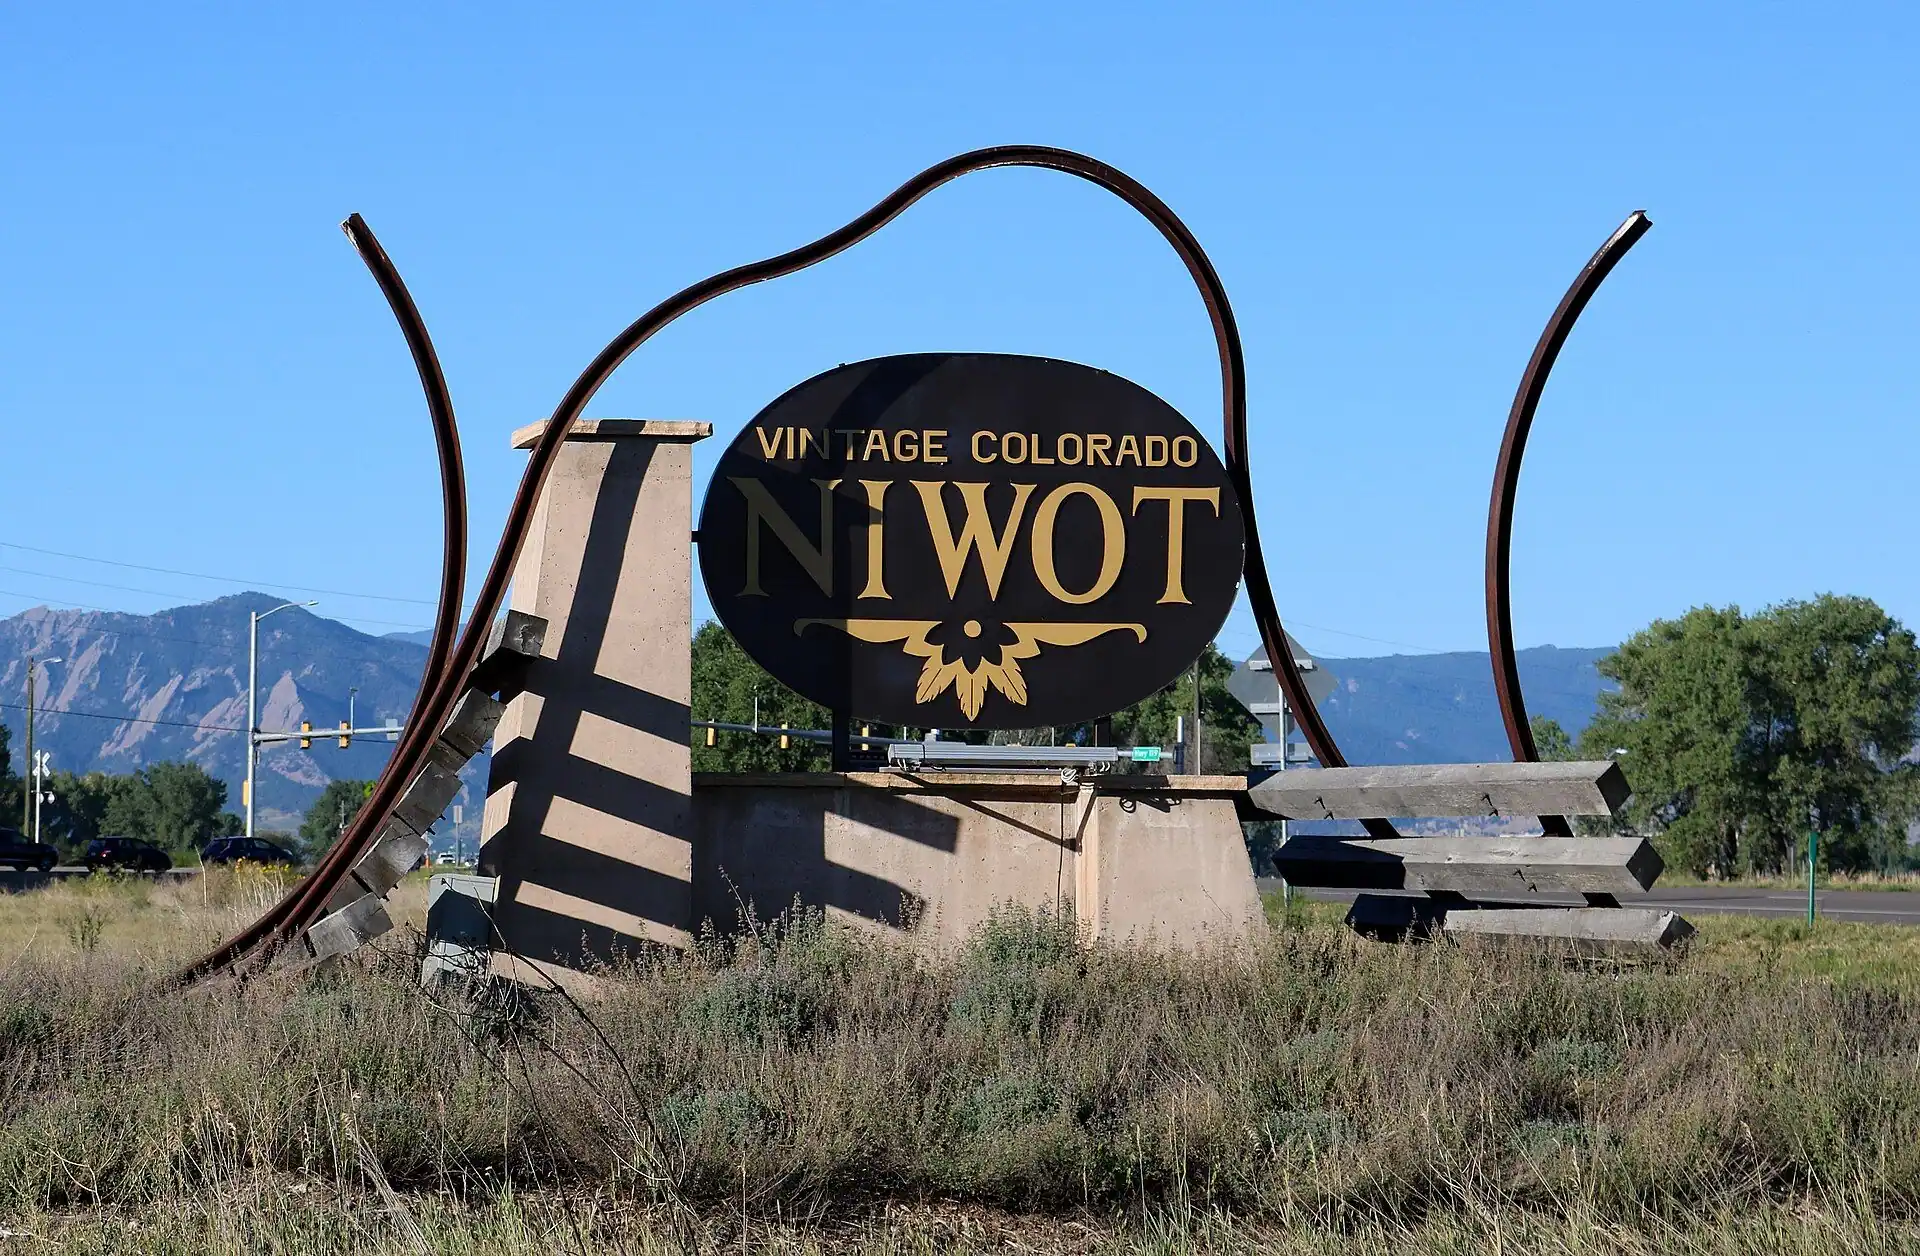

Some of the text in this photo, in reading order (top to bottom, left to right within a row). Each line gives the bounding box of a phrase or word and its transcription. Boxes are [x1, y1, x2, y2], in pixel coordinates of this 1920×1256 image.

[756, 426, 1199, 468] VINTAGE COLORADO
[726, 476, 1221, 605] NIWOT
